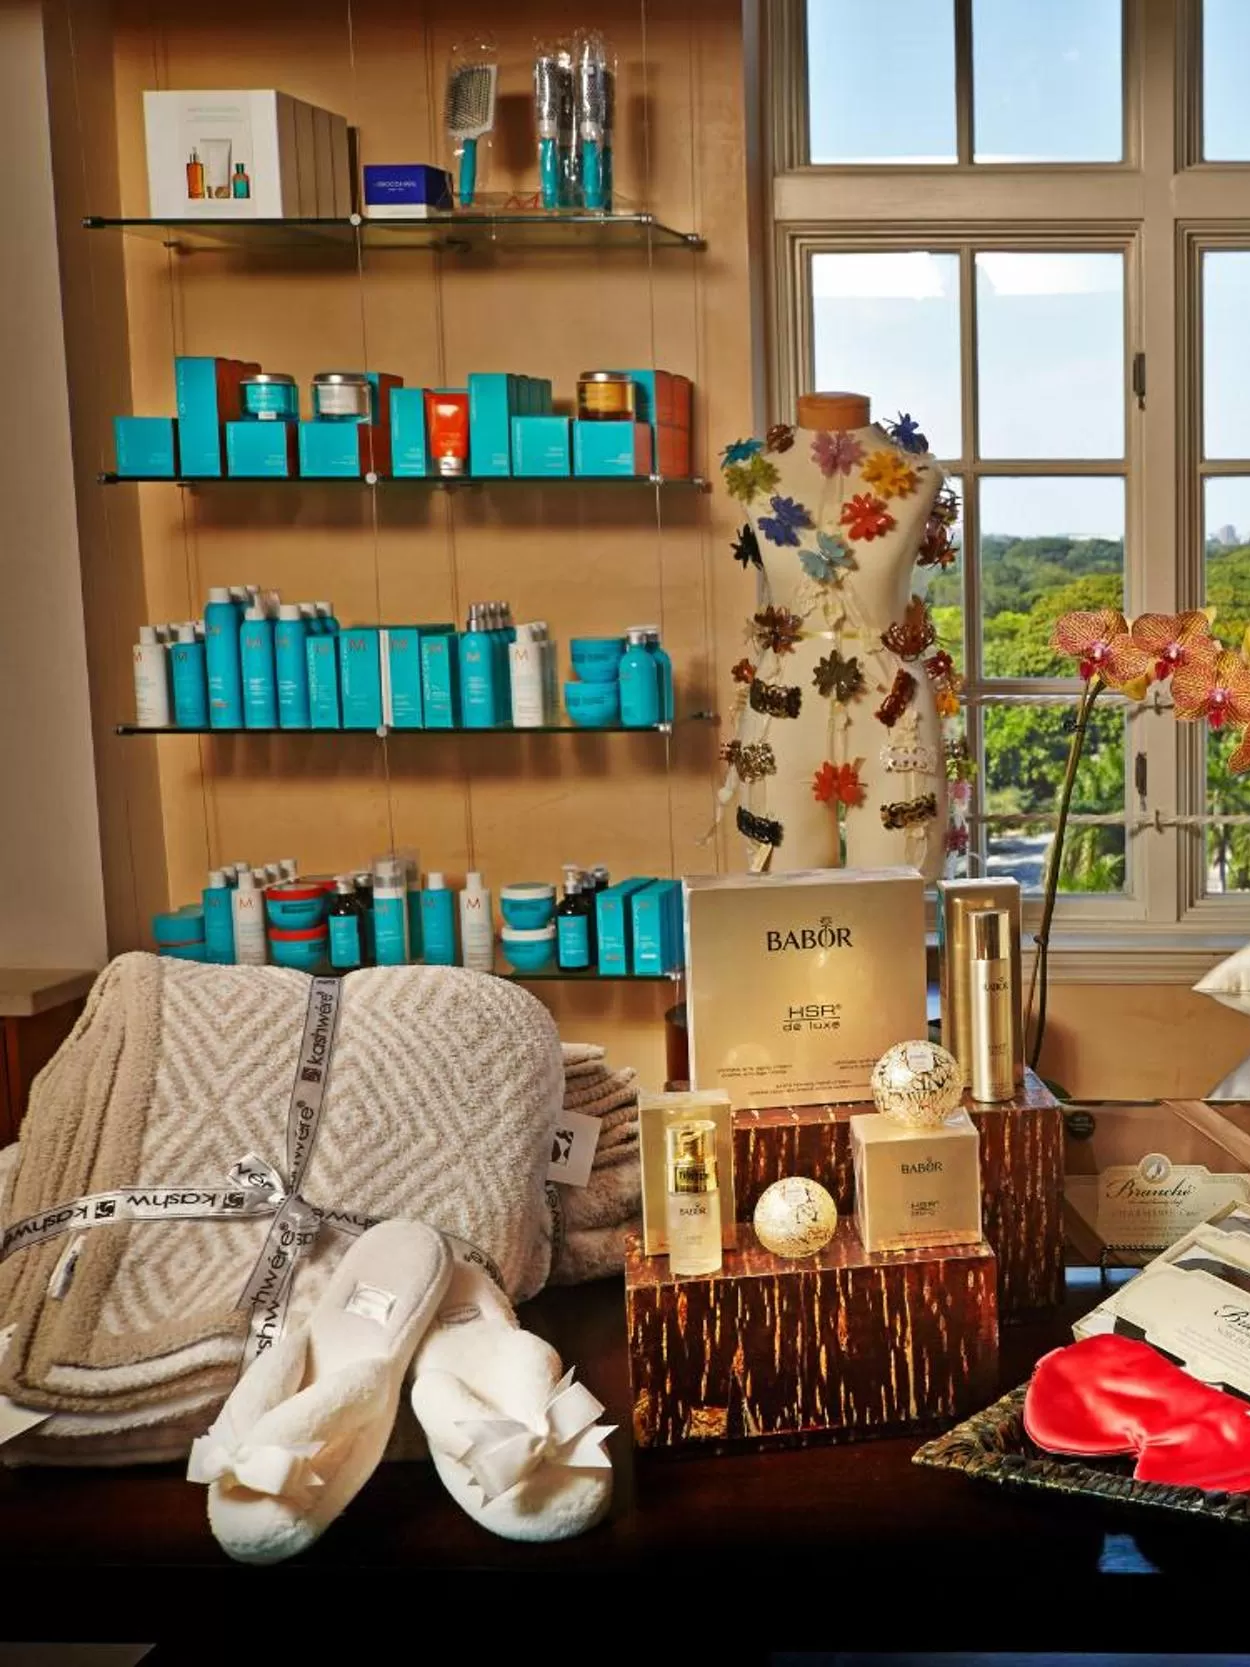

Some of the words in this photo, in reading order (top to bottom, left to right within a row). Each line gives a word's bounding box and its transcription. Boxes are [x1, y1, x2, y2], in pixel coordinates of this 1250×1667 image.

[515, 649, 528, 664] M
[466, 898, 481, 912] M
[767, 924, 853, 951] BABOR
[783, 1022, 801, 1031] de
[809, 1021, 840, 1031] luxe
[901, 1160, 943, 1174] BABOR
